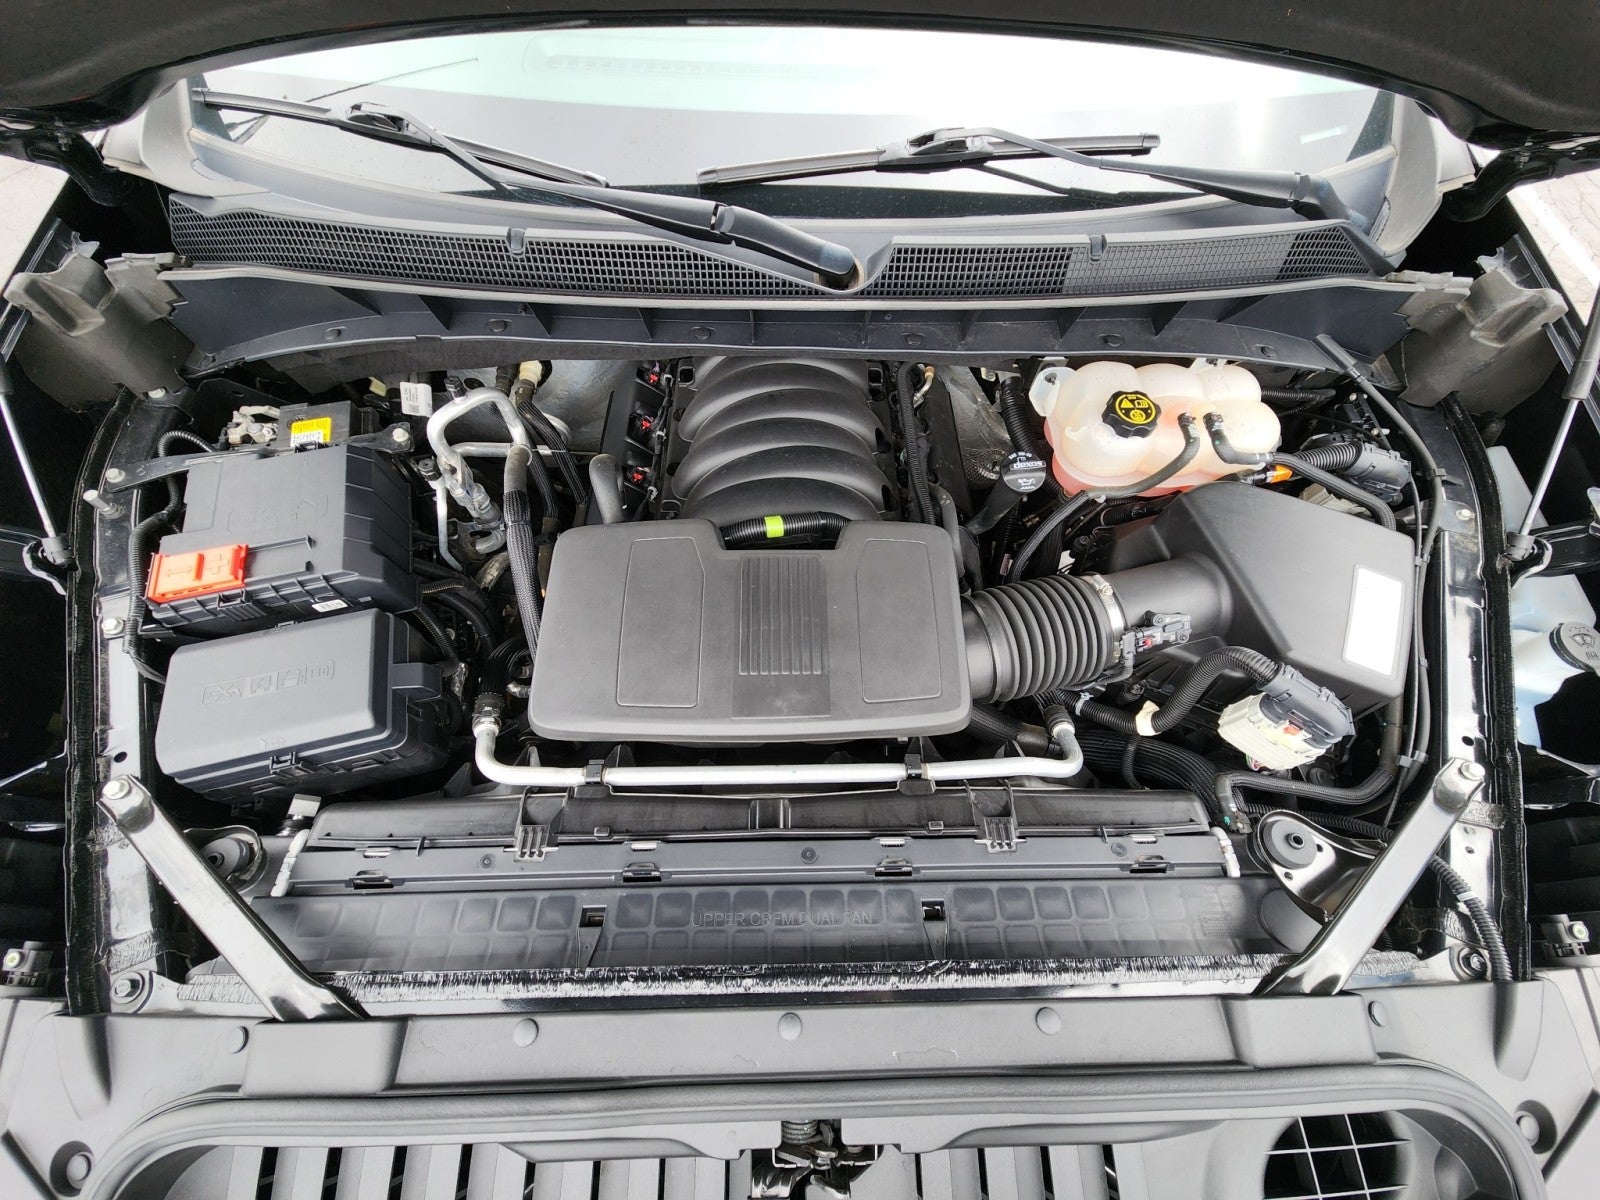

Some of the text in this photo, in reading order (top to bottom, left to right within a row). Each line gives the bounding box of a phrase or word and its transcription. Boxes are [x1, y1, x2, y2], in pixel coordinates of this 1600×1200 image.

[1013, 459, 1043, 469] dexos
[691, 911, 745, 927] UPPER
[799, 911, 839, 926] DUAL
[843, 911, 873, 925] FAN
